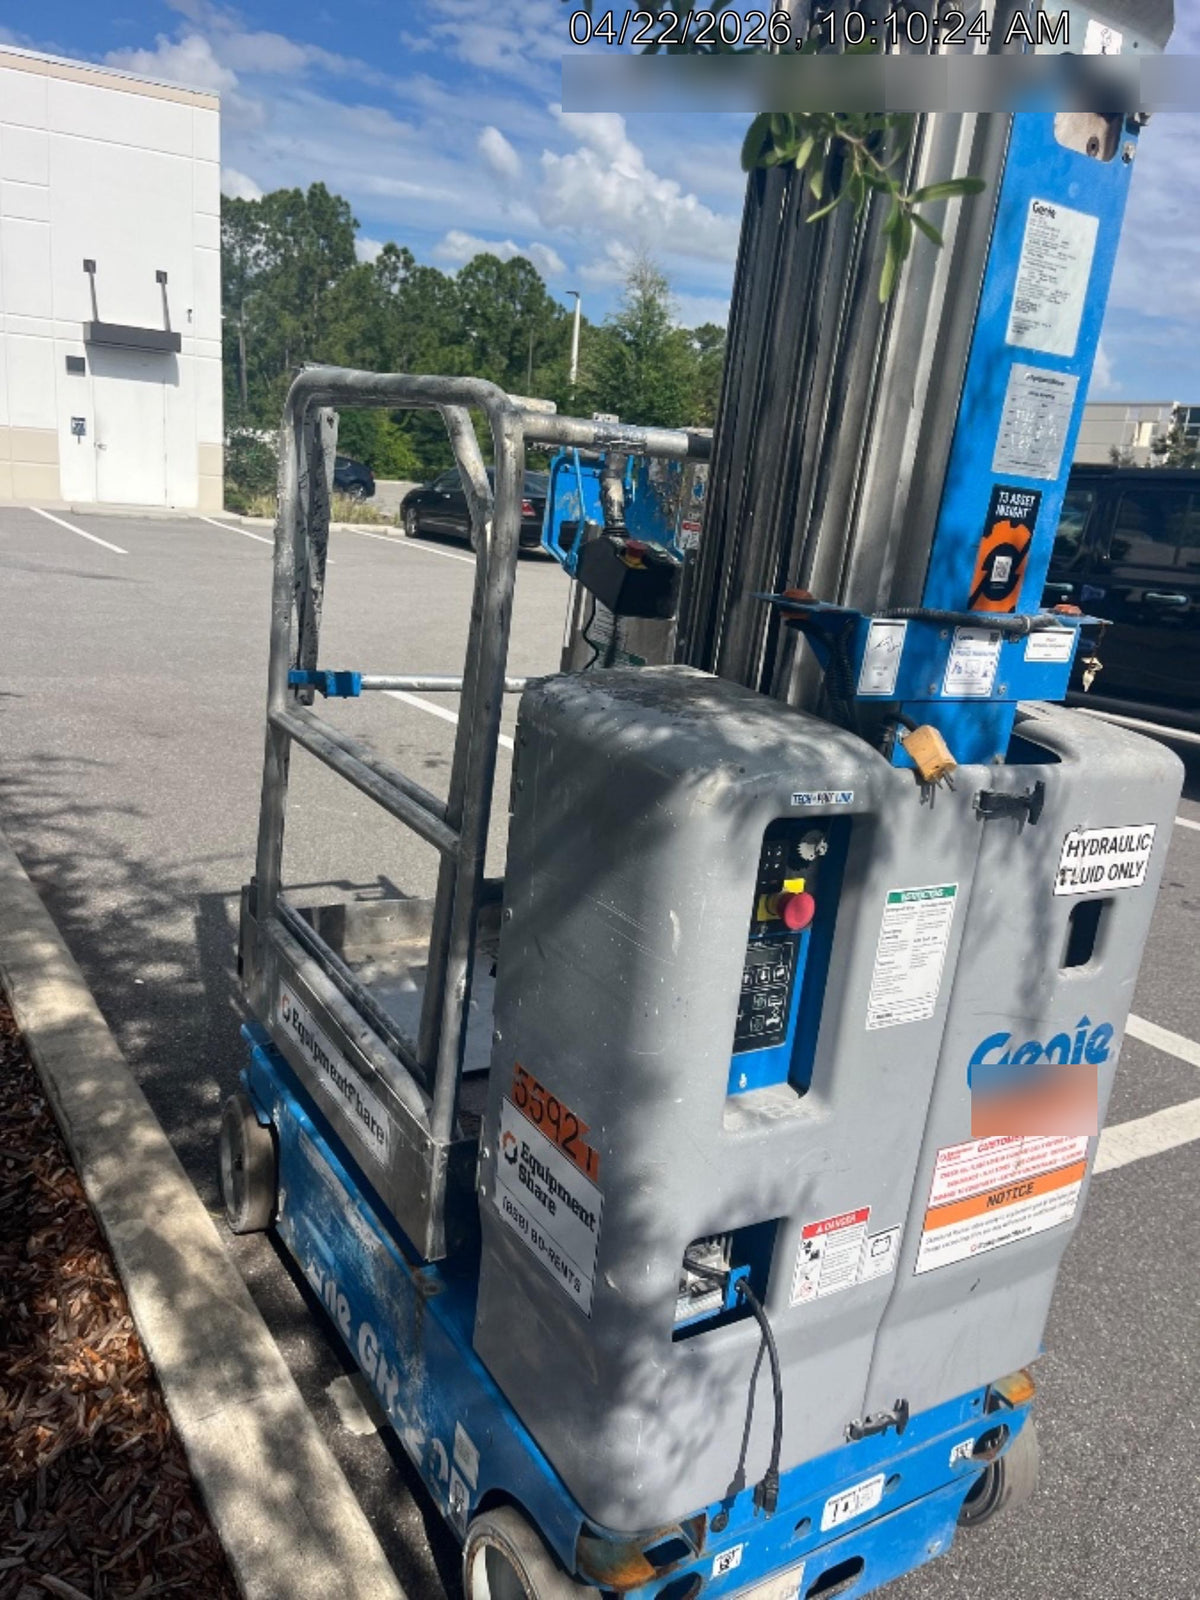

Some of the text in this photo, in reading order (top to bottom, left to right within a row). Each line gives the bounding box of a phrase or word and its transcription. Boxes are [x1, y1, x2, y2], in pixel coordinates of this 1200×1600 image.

[1066, 833, 1151, 857] HYDRAULIC
[1107, 861, 1144, 881] ONLY
[512, 1066, 593, 1172] 55921
[518, 1165, 557, 1217] Share
[520, 1141, 597, 1233] Equipment
[986, 1182, 1035, 1208] NOTICE
